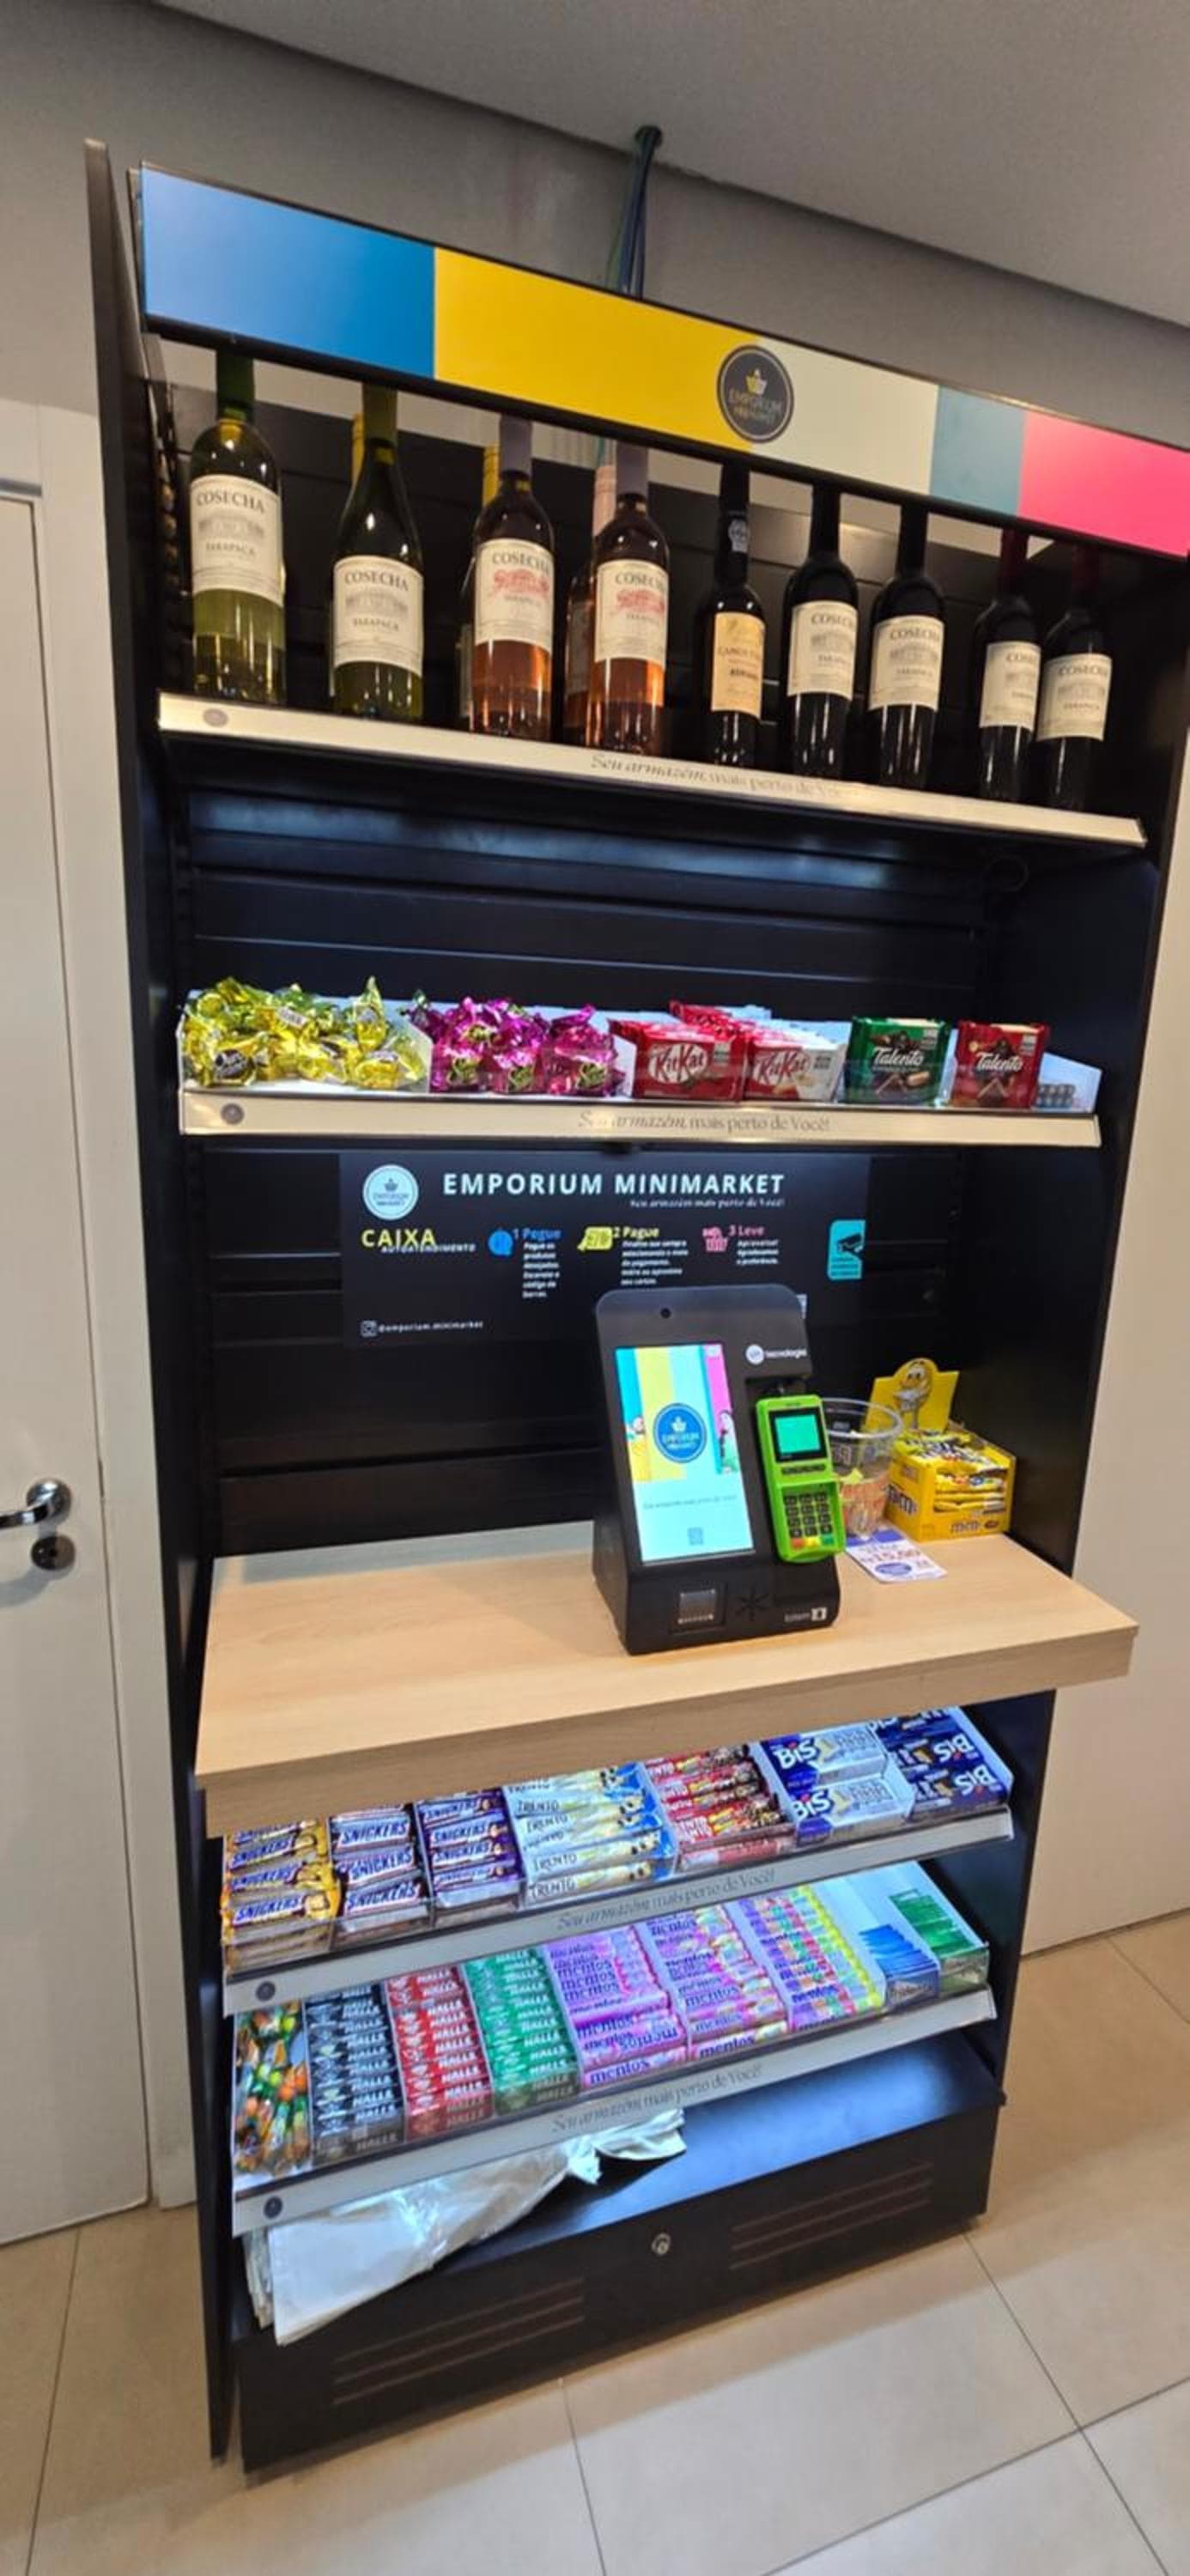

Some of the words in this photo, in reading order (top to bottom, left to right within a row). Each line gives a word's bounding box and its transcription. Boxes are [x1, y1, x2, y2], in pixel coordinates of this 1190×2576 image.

[197, 490, 264, 513] COSECHA
[345, 570, 409, 592] COSECHA
[873, 1046, 925, 1066] Talento
[975, 1052, 1023, 1072] Talento
[689, 1115, 726, 1128] mais
[727, 1117, 768, 1134] perto
[771, 1116, 789, 1130] de
[443, 1173, 602, 1195] EMPORIUM
[615, 1173, 785, 1194] MINIMARKET
[361, 1229, 437, 1248] CAIXA
[522, 1228, 562, 1242] Pegue
[612, 1227, 620, 1239] 2
[622, 1226, 660, 1241] Pague
[728, 1224, 736, 1236] 3
[738, 1224, 765, 1236] Leve
[519, 1799, 560, 1812] TRENTO
[341, 1822, 406, 1844] SNICKERS
[434, 1821, 487, 1839] SNICKERS
[526, 1813, 568, 1833] TRENTO
[435, 1840, 489, 1862] SNICKERS
[350, 1850, 410, 1880] SNICKERS
[535, 1854, 577, 1871] TRENTO
[346, 1880, 415, 1911] SNICKERS
[528, 1874, 577, 1897] TRENTO
[236, 1897, 298, 1922] SNICKERS
[562, 1971, 616, 1990] mentos
[564, 1982, 620, 2002] mentos
[686, 1986, 739, 2007] mentos
[433, 2024, 469, 2041] HALLS
[576, 2013, 634, 2039] mentos
[435, 2036, 472, 2055] HALLS
[524, 2029, 560, 2048] HALLS
[700, 2035, 755, 2059] mentos
[439, 2050, 476, 2069] HALLS
[531, 2044, 567, 2061] HALLS
[441, 2066, 479, 2084] HALLS
[590, 2060, 650, 2085] mentos
[353, 2088, 393, 2108] HALLS
[444, 2081, 483, 2100] HALLS
[355, 2104, 396, 2124] HALLS
